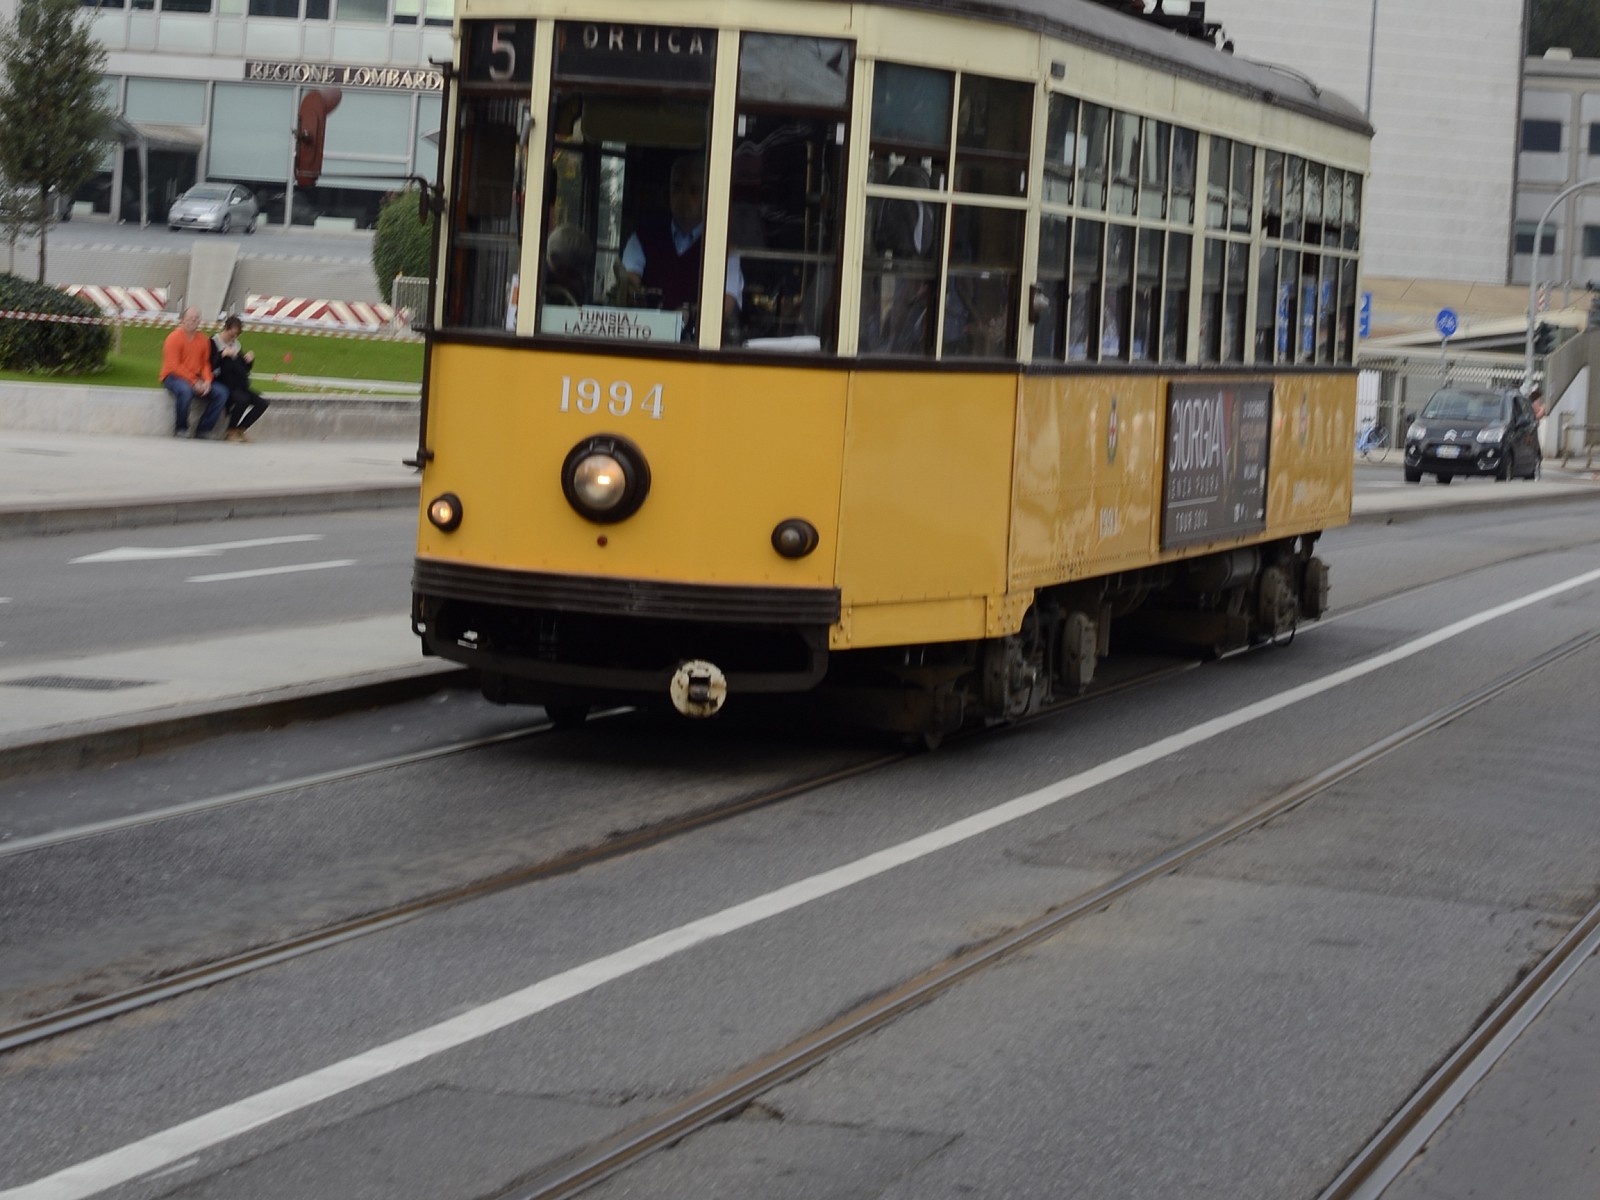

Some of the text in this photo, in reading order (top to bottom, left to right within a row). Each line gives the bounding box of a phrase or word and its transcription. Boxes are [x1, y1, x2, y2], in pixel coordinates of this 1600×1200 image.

[488, 22, 517, 81] 5
[582, 24, 704, 55] ORTICA
[250, 60, 335, 85] REGIONE
[563, 320, 652, 340] LAZZARETTO
[579, 309, 630, 325] TUNISIA
[560, 375, 664, 420] 1994
[1169, 395, 1223, 473] GIORGIA
